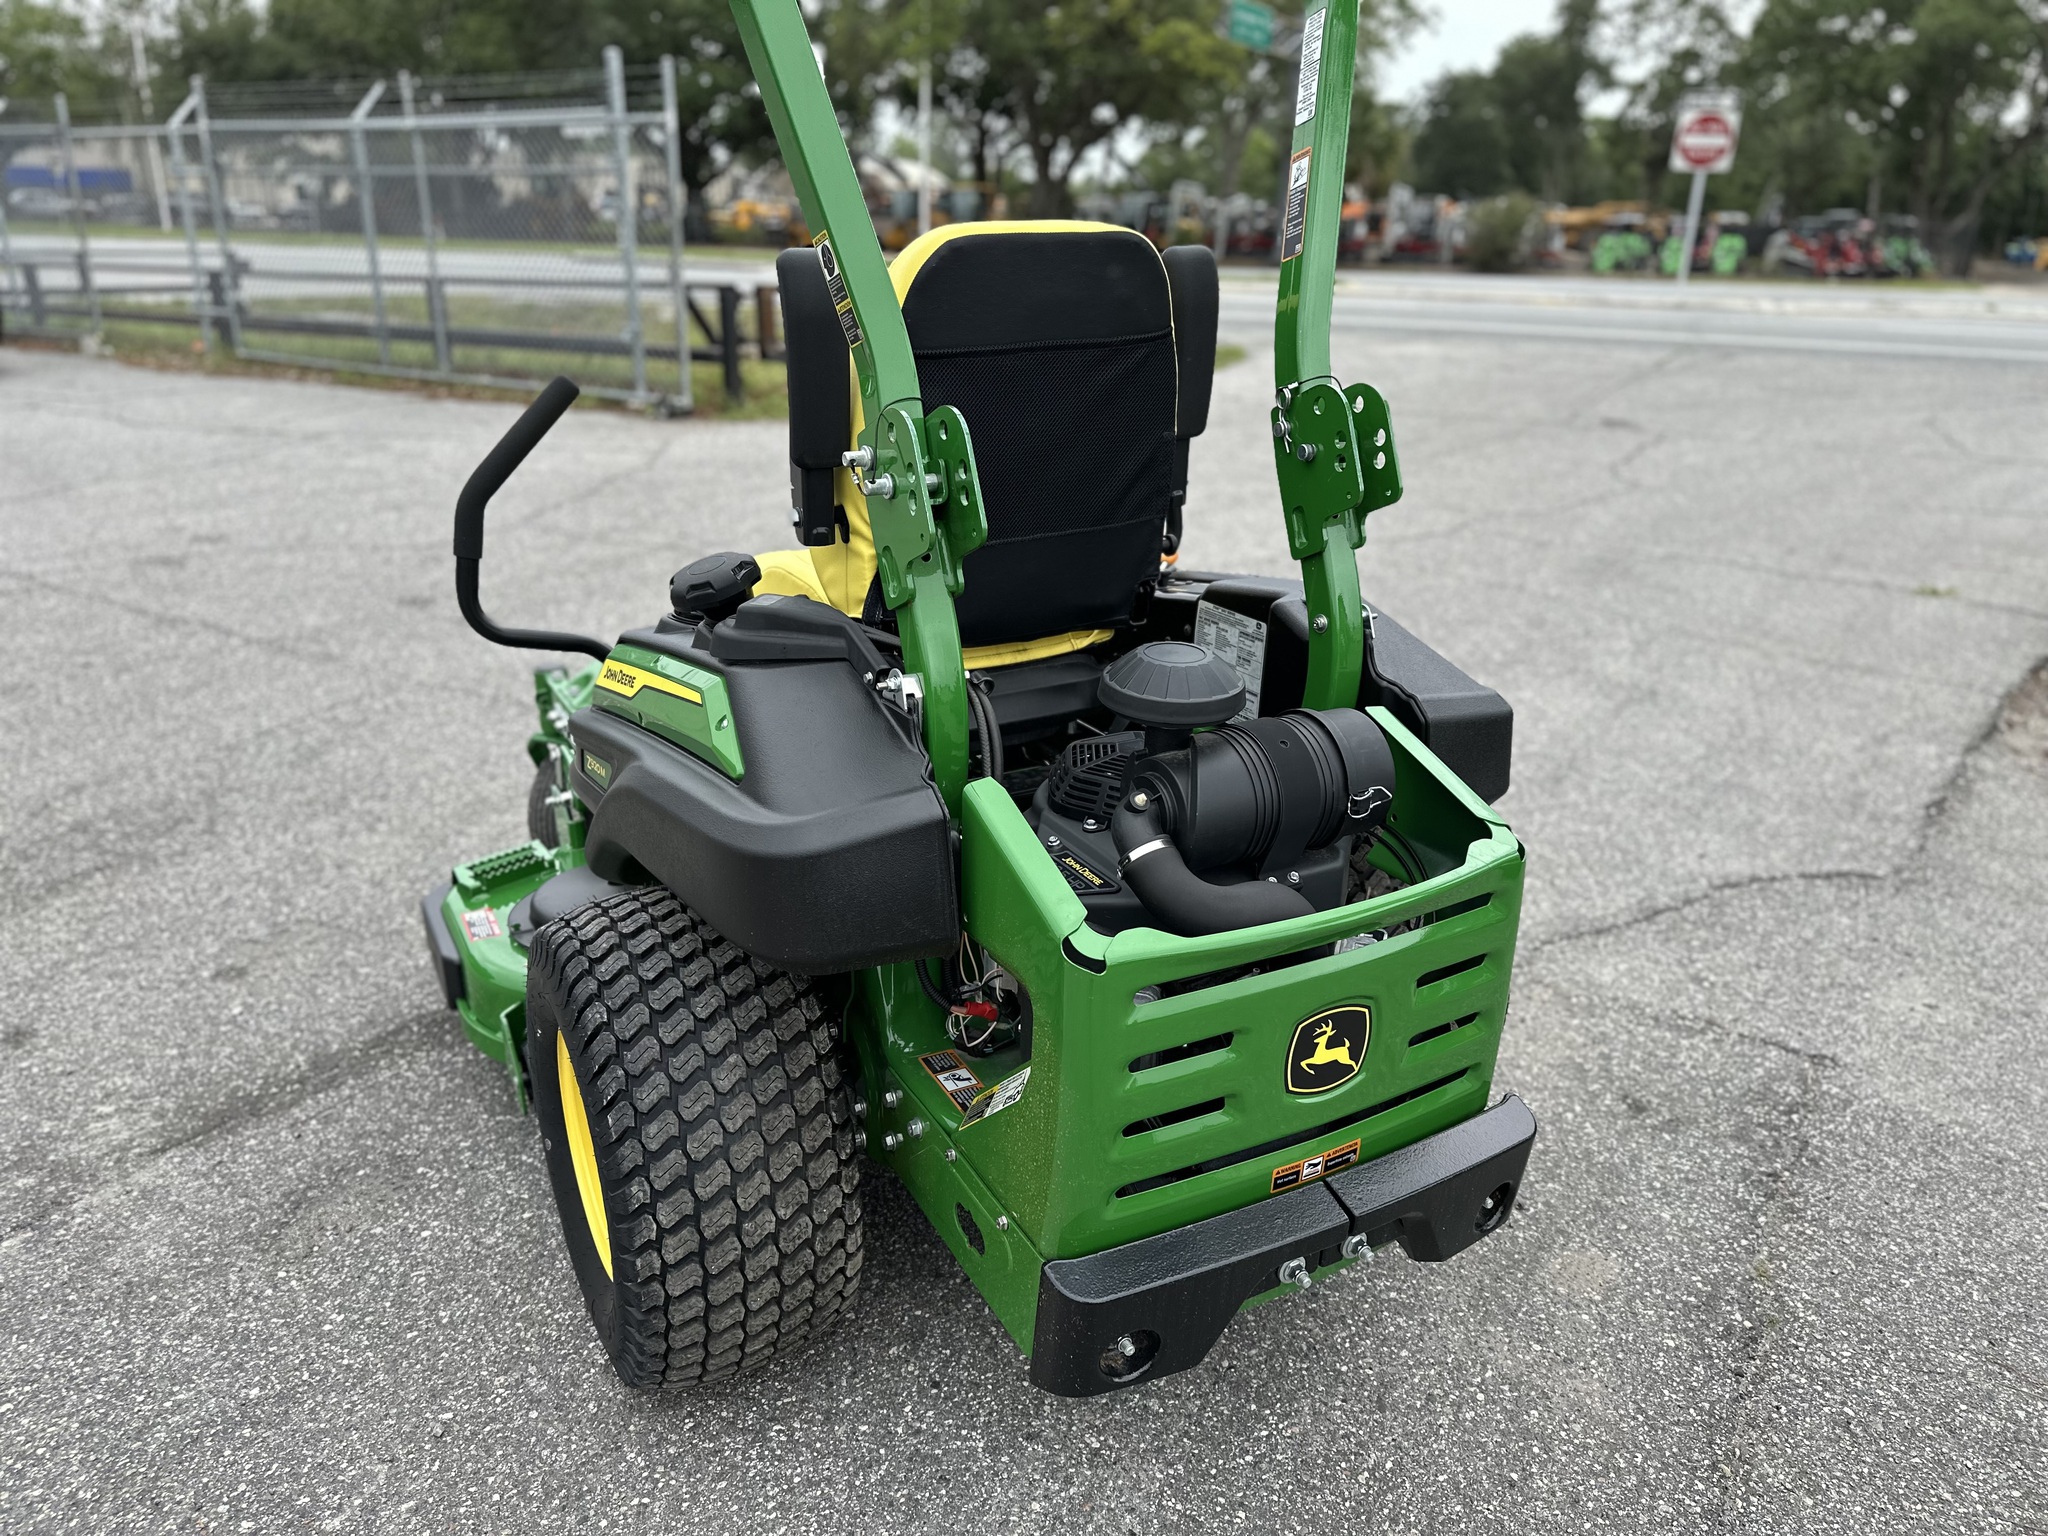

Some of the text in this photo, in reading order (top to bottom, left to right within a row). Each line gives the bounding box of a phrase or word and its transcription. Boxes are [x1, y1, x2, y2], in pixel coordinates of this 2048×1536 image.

[604, 665, 636, 688] JOHN DEERE
[1061, 857, 1082, 871] JOHN
[1079, 867, 1104, 886] DEERE
[1331, 1141, 1358, 1156] ADVERTENCIA
[1280, 1163, 1301, 1174] WARNING
